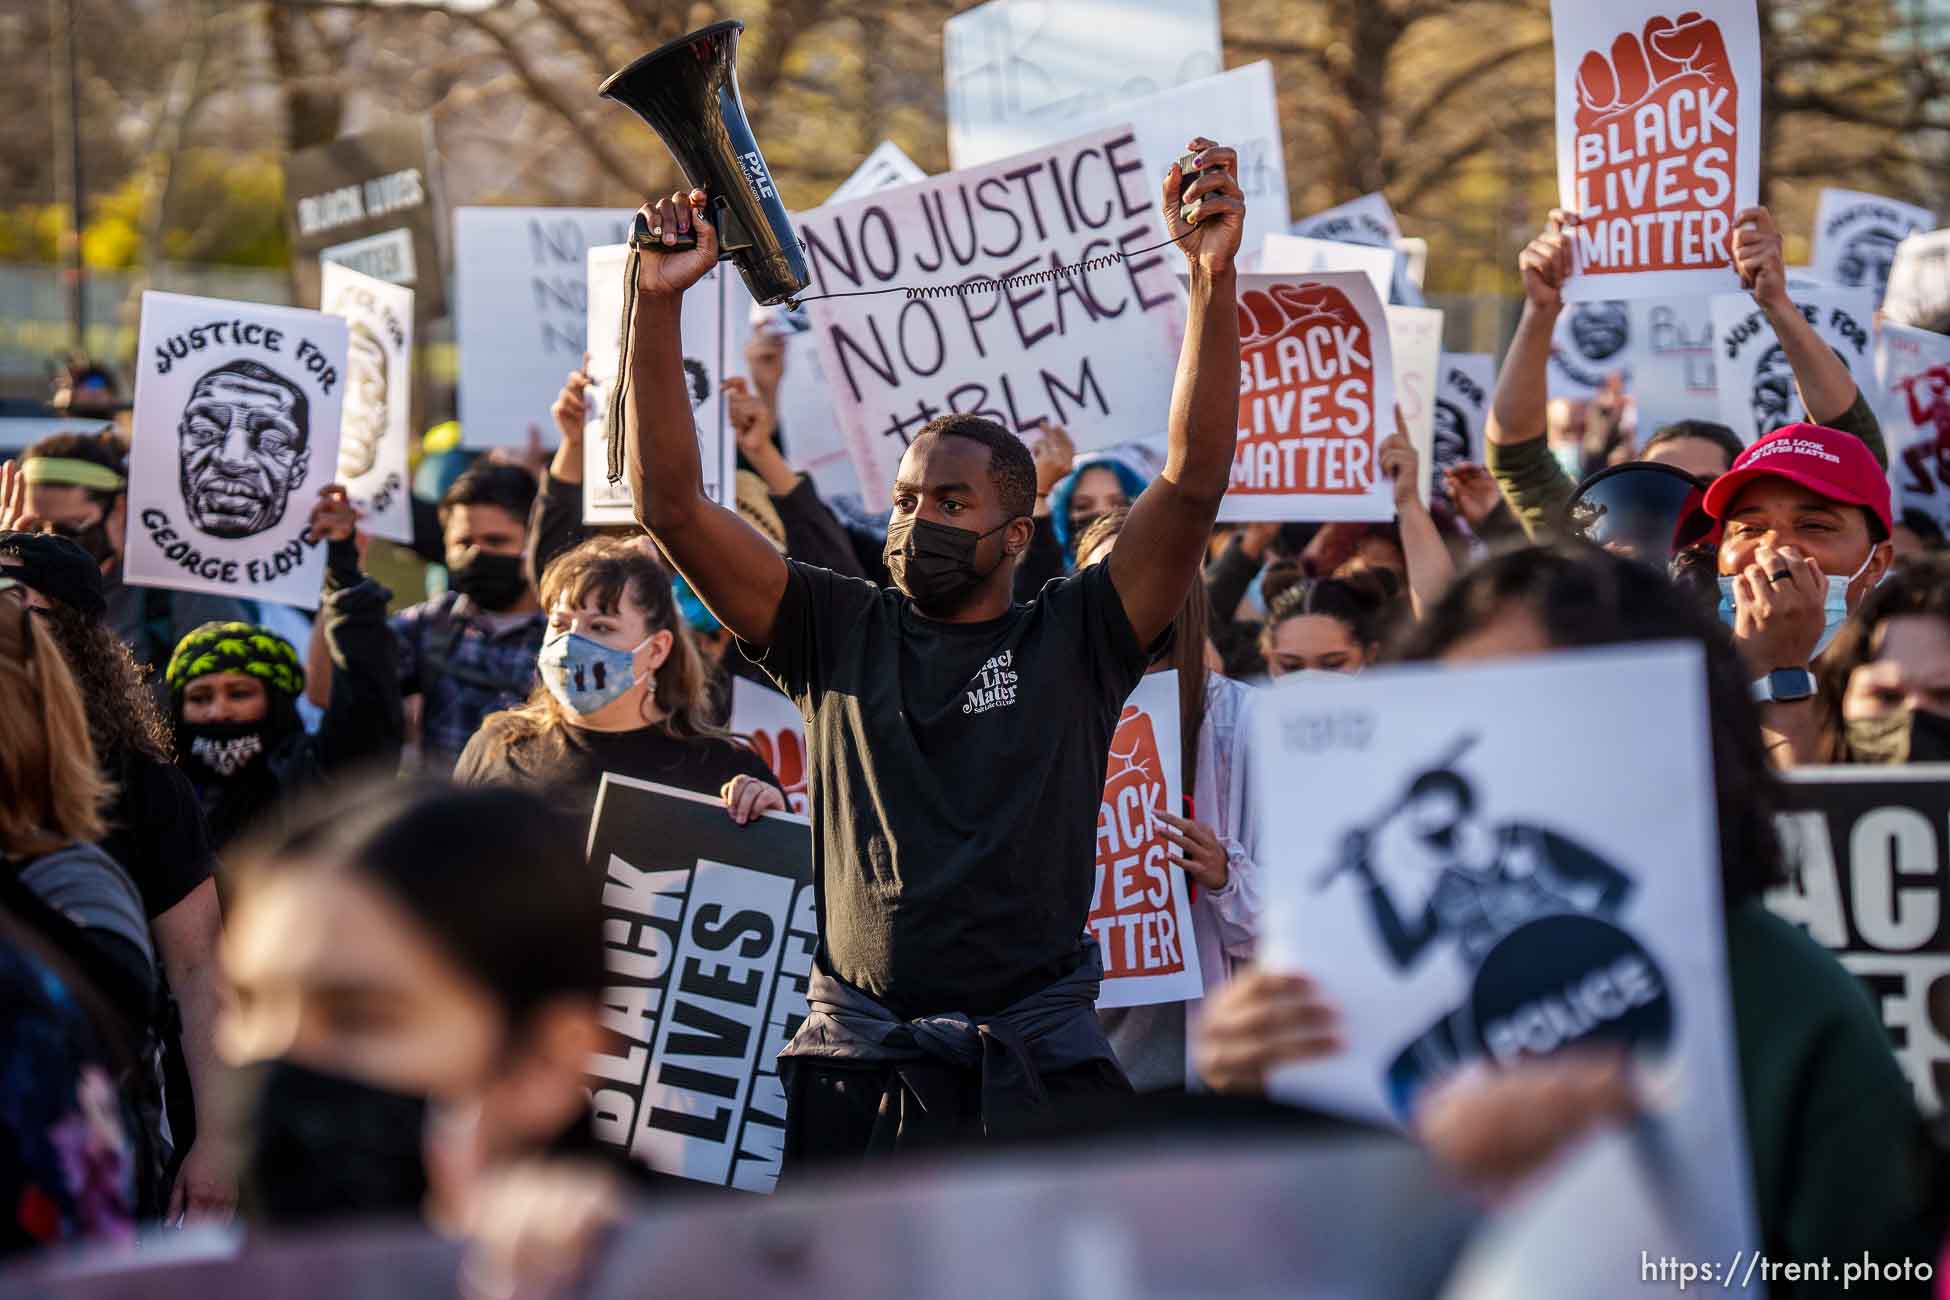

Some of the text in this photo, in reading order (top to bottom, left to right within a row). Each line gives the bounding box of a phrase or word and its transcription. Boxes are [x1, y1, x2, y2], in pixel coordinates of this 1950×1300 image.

[1577, 86, 1735, 173] BLACK
[744, 151, 775, 199] PYLE
[1577, 146, 1732, 220] LIVES
[800, 206, 900, 296] NO
[914, 133, 1153, 273] JUSTICE
[1577, 208, 1732, 268] MATTER
[829, 225, 1177, 402] NO PEACE
[1724, 303, 1819, 359] JUSE
[1829, 308, 1867, 355] FOR
[155, 319, 338, 396] JUSTICE FOR
[1240, 325, 1371, 396] BLACK
[883, 356, 1110, 452] #BLM
[1231, 437, 1375, 489] MATTER
[1792, 438, 1824, 452] LOOK
[1794, 446, 1841, 464] MATTER
[141, 507, 239, 584] GEORGE
[962, 684, 1018, 714] Mater
[980, 667, 1018, 689] Lies
[1096, 782, 1168, 858] ACK
[1090, 844, 1170, 912] VES
[1088, 909, 1181, 975] TTER
[588, 853, 691, 1147] BLACK
[647, 903, 775, 1143] LIVES
[1486, 954, 1660, 1064] POLICE
